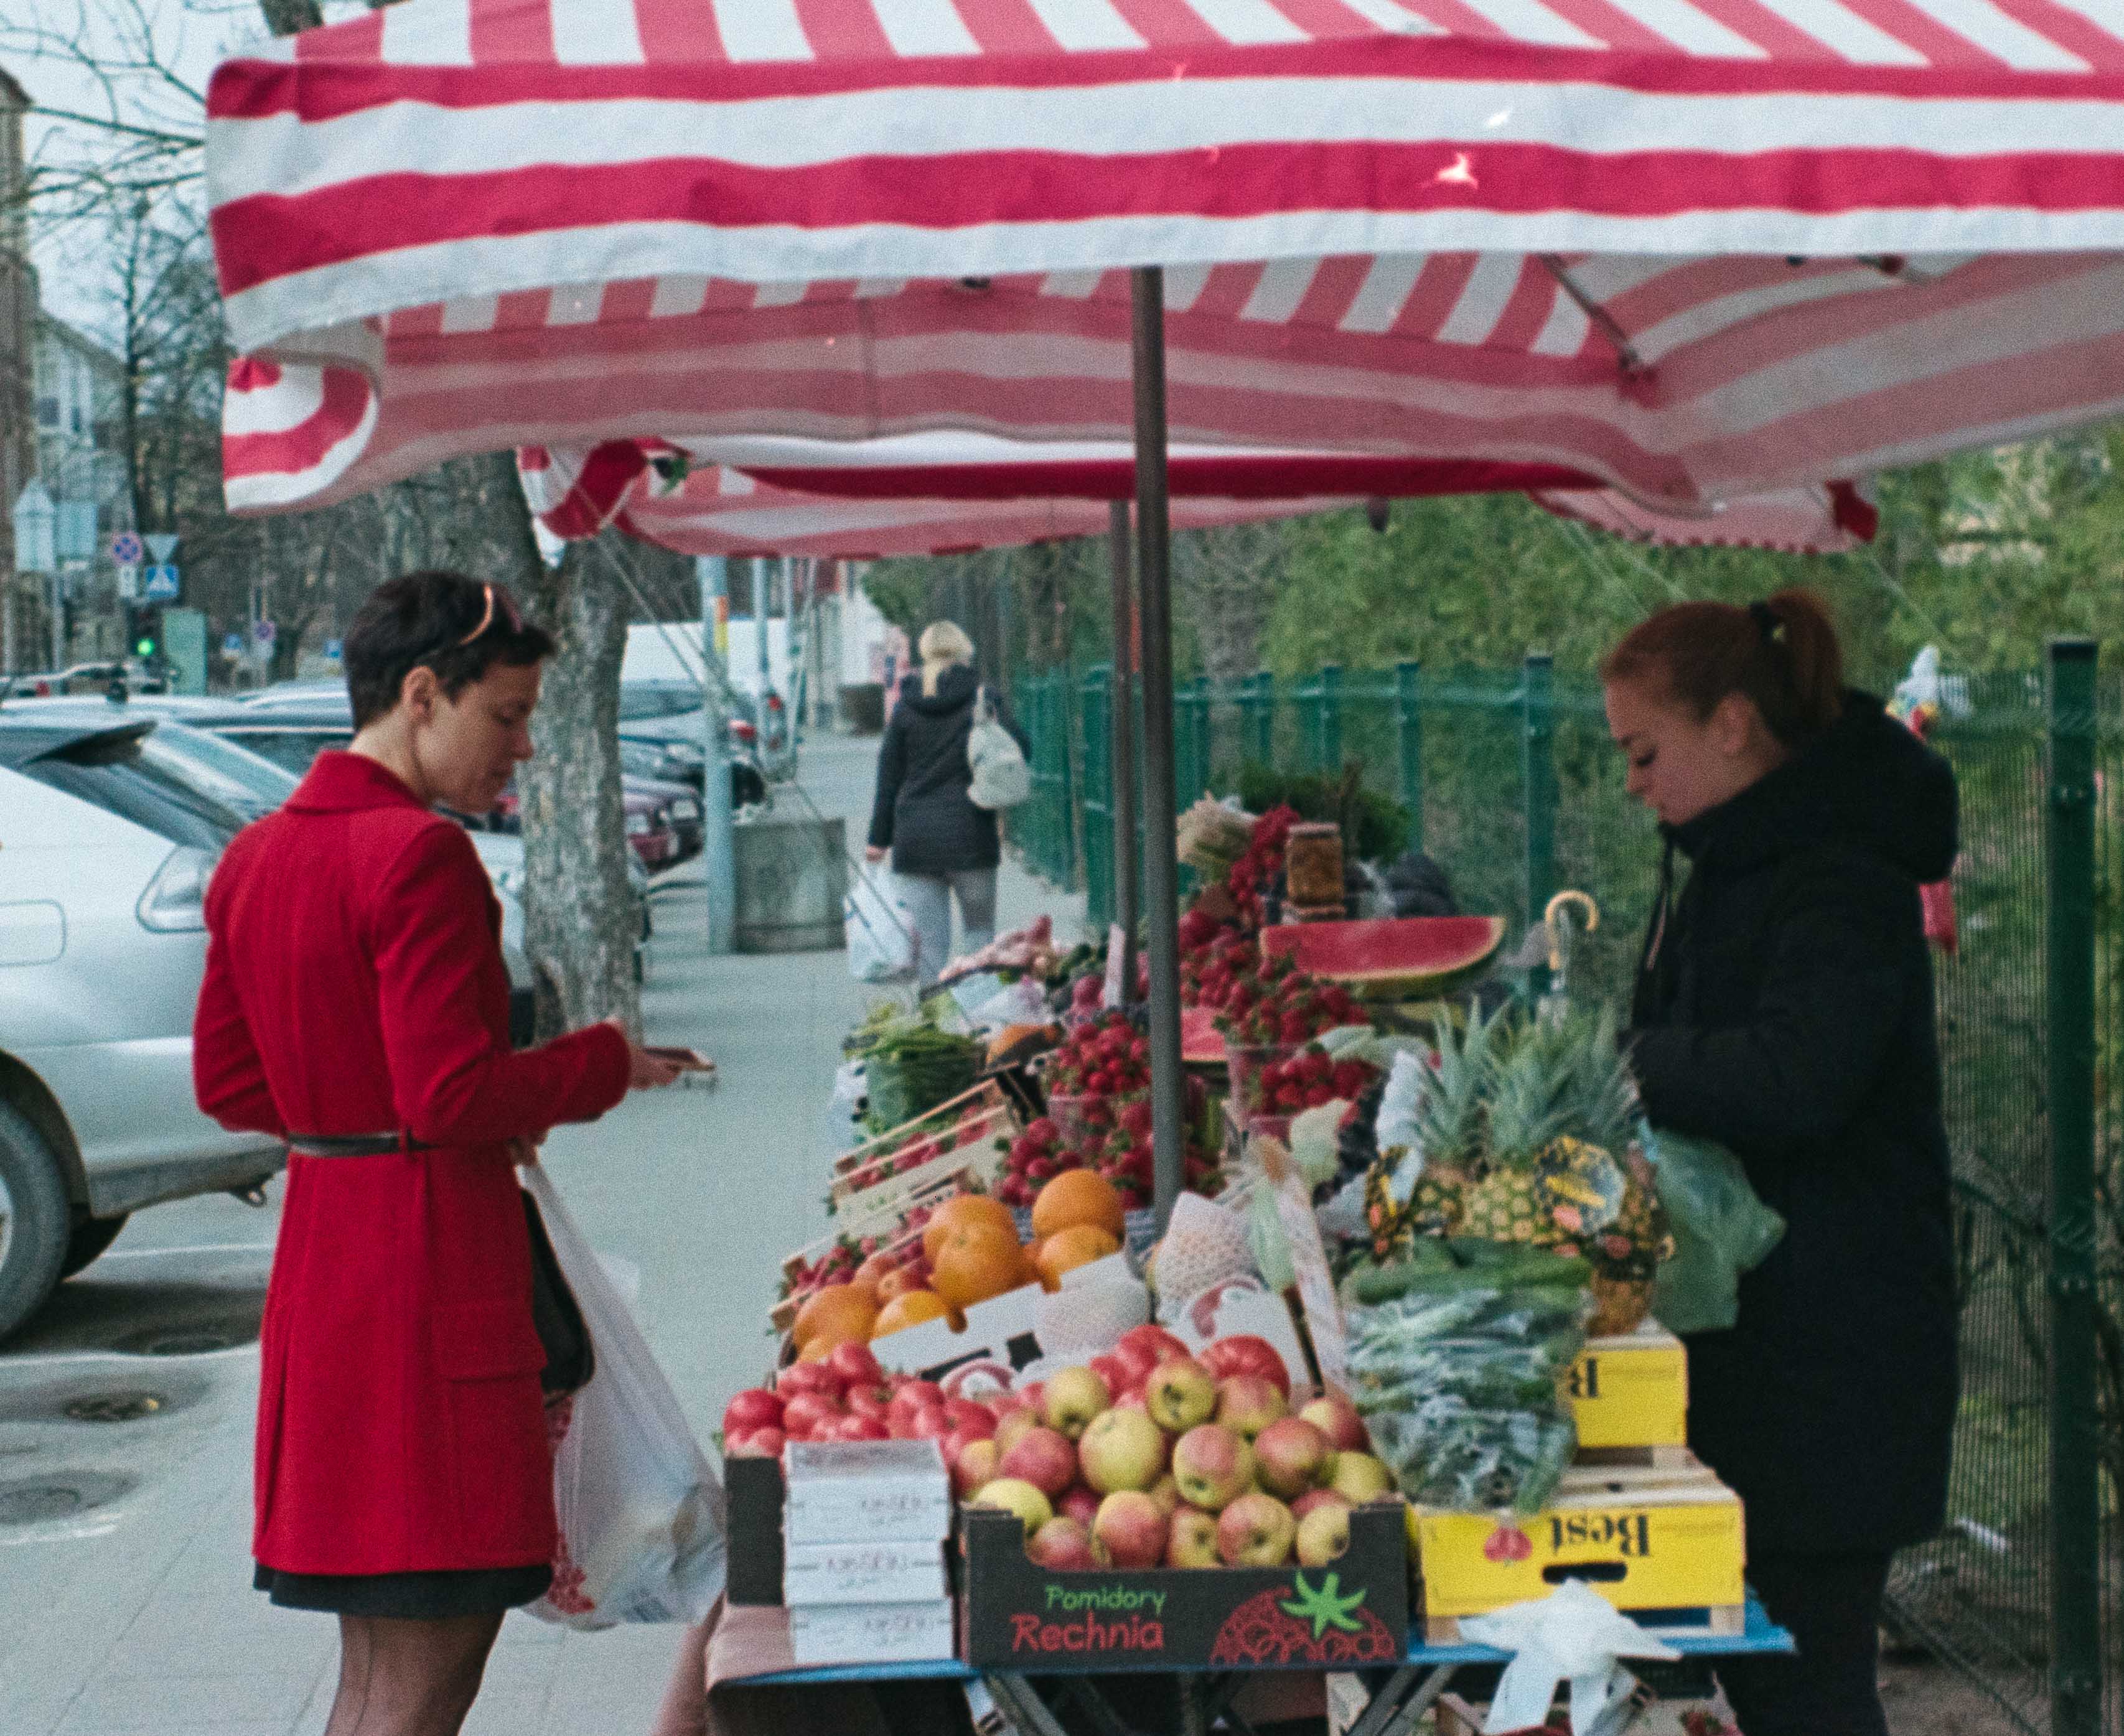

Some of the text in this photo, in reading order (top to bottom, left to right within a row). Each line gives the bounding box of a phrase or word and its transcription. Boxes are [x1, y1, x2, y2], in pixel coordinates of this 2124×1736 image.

[1551, 1513, 1650, 1557] Best
[1044, 1584, 1167, 1617] Pomidory
[1009, 1609, 1165, 1653] Rechnia
